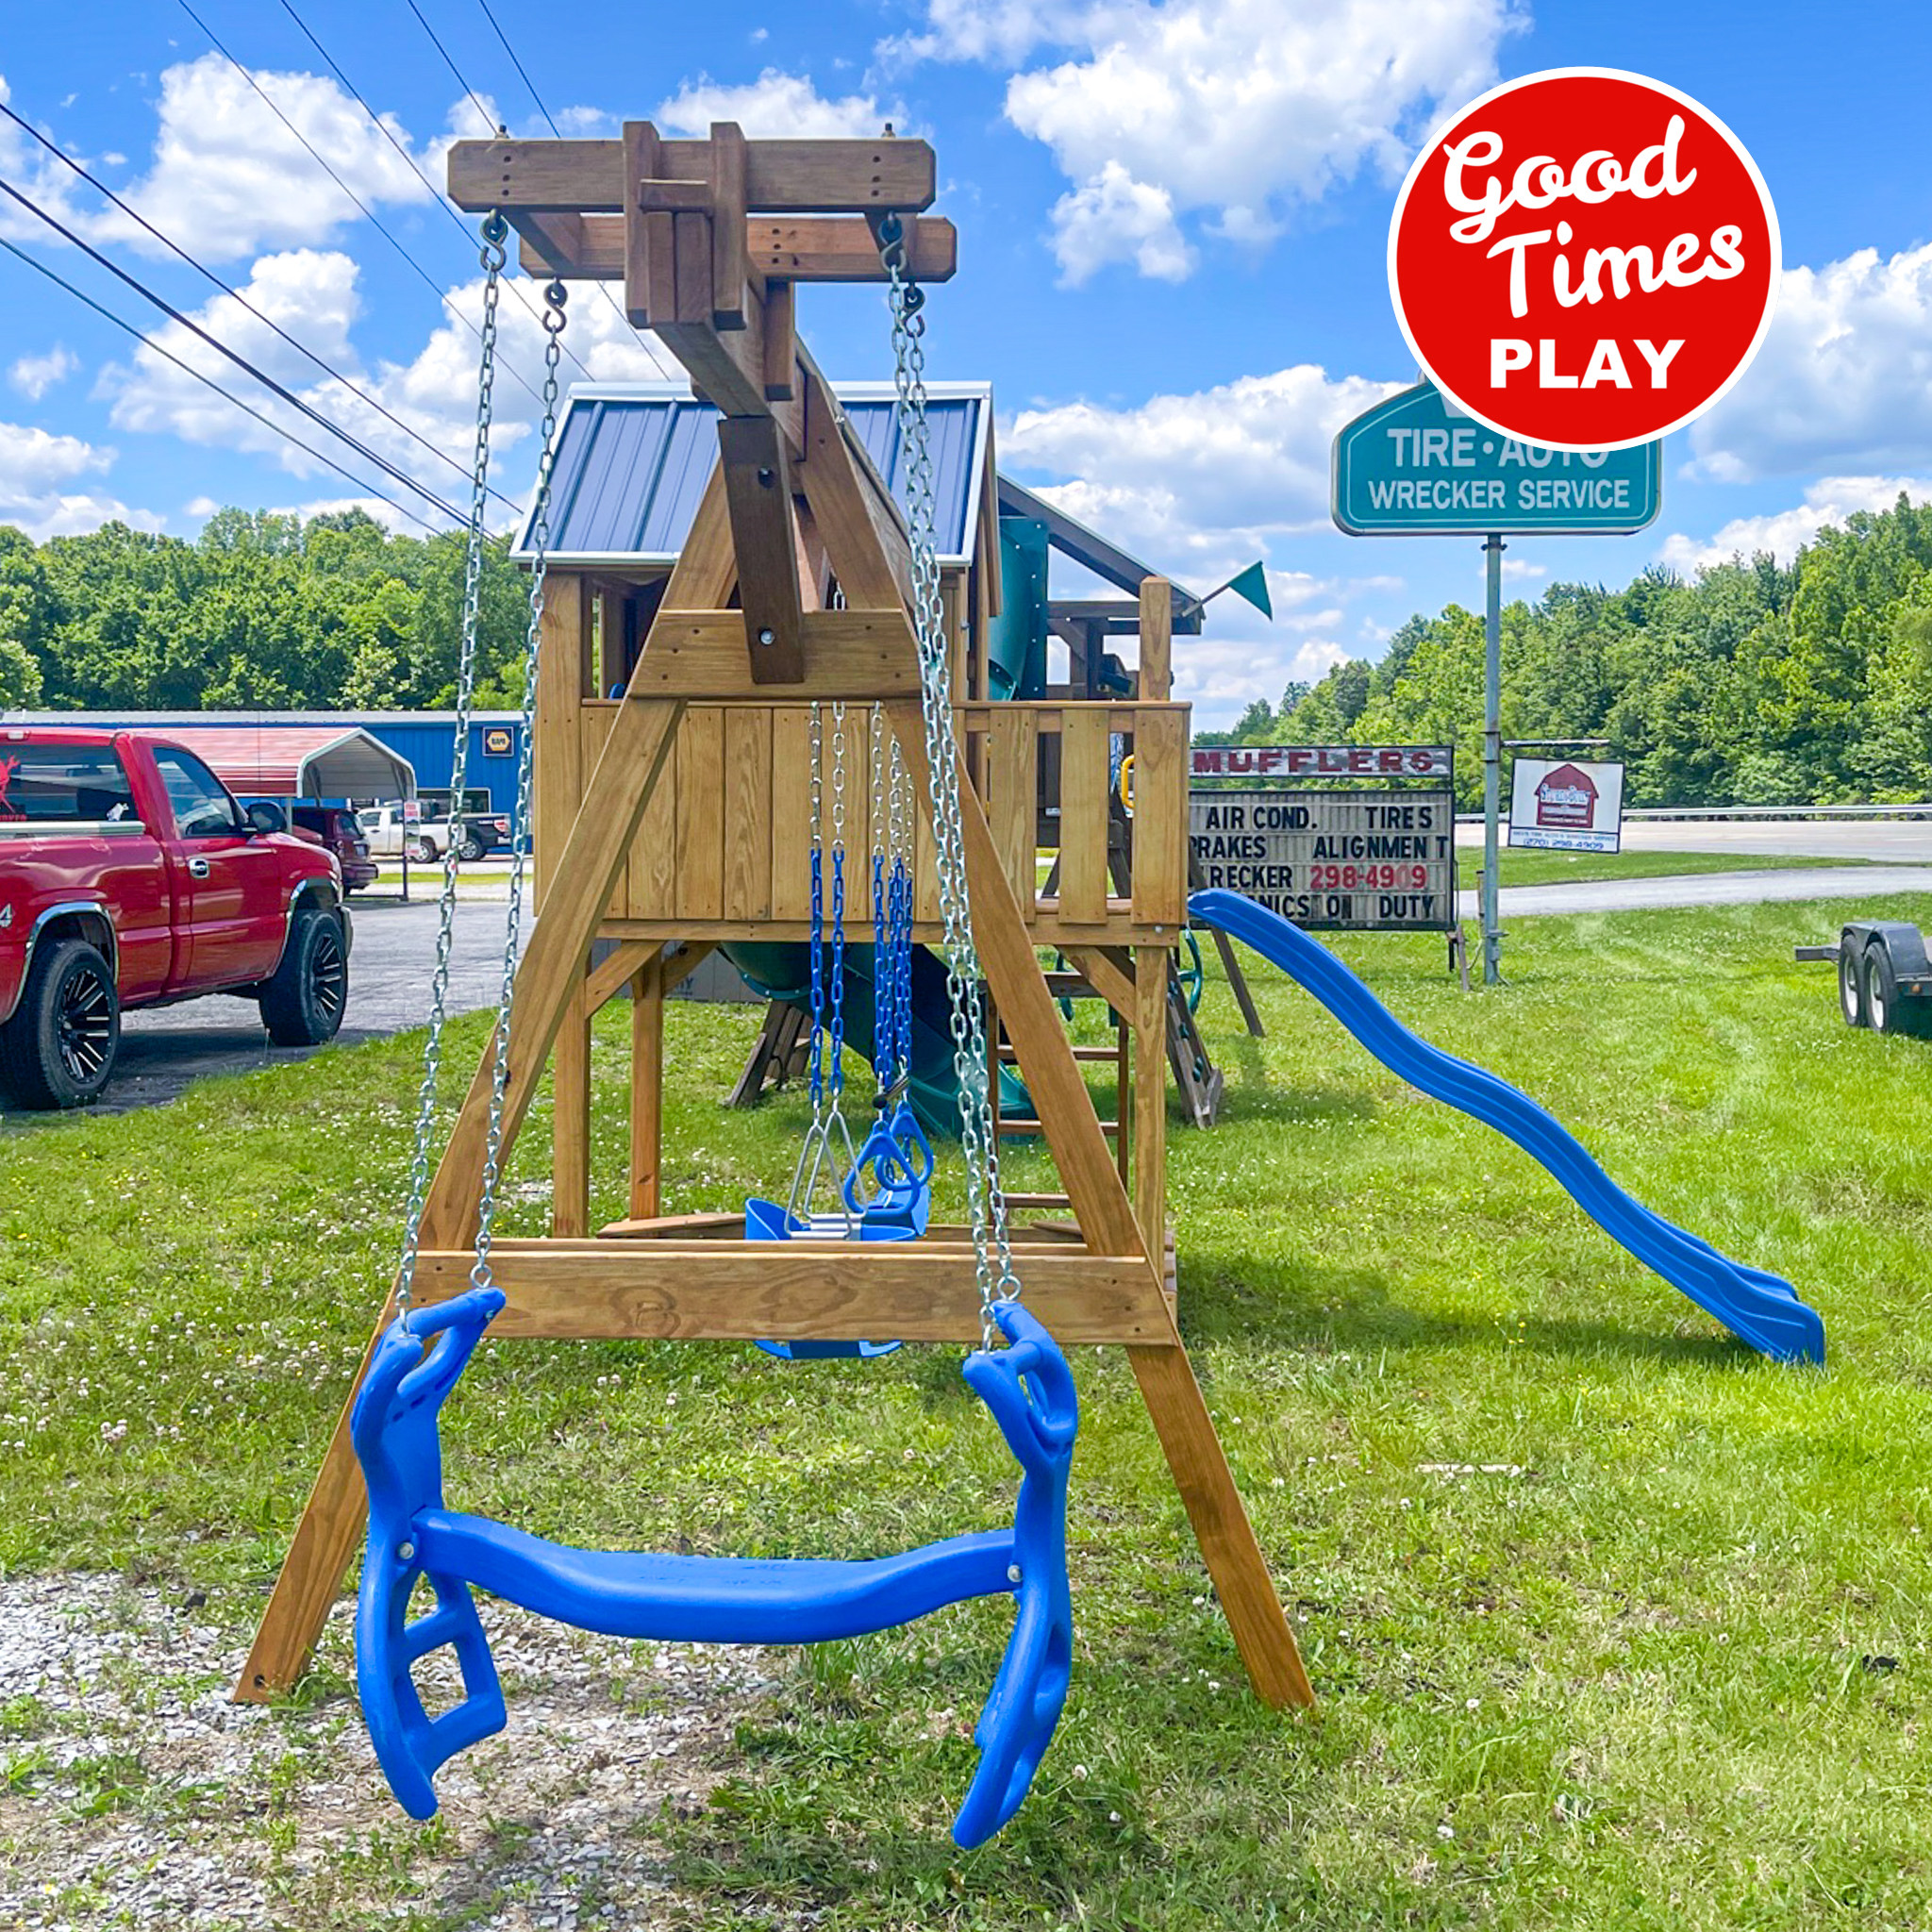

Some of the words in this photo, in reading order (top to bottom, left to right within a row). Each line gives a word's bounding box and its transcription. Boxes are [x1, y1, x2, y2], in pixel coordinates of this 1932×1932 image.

[1387, 428, 1477, 468] TIRE
[1368, 480, 1507, 509] WRECKER
[1518, 479, 1630, 509] SERVICE
[1192, 751, 1436, 773] MUFFLERS
[1206, 807, 1245, 829] AIR
[1253, 807, 1318, 829] COND.
[1365, 807, 1432, 829] TIRES
[1189, 866, 1292, 889] RECKER
[1309, 865, 1427, 889] 298-4909
[1380, 895, 1434, 918] DUTY
